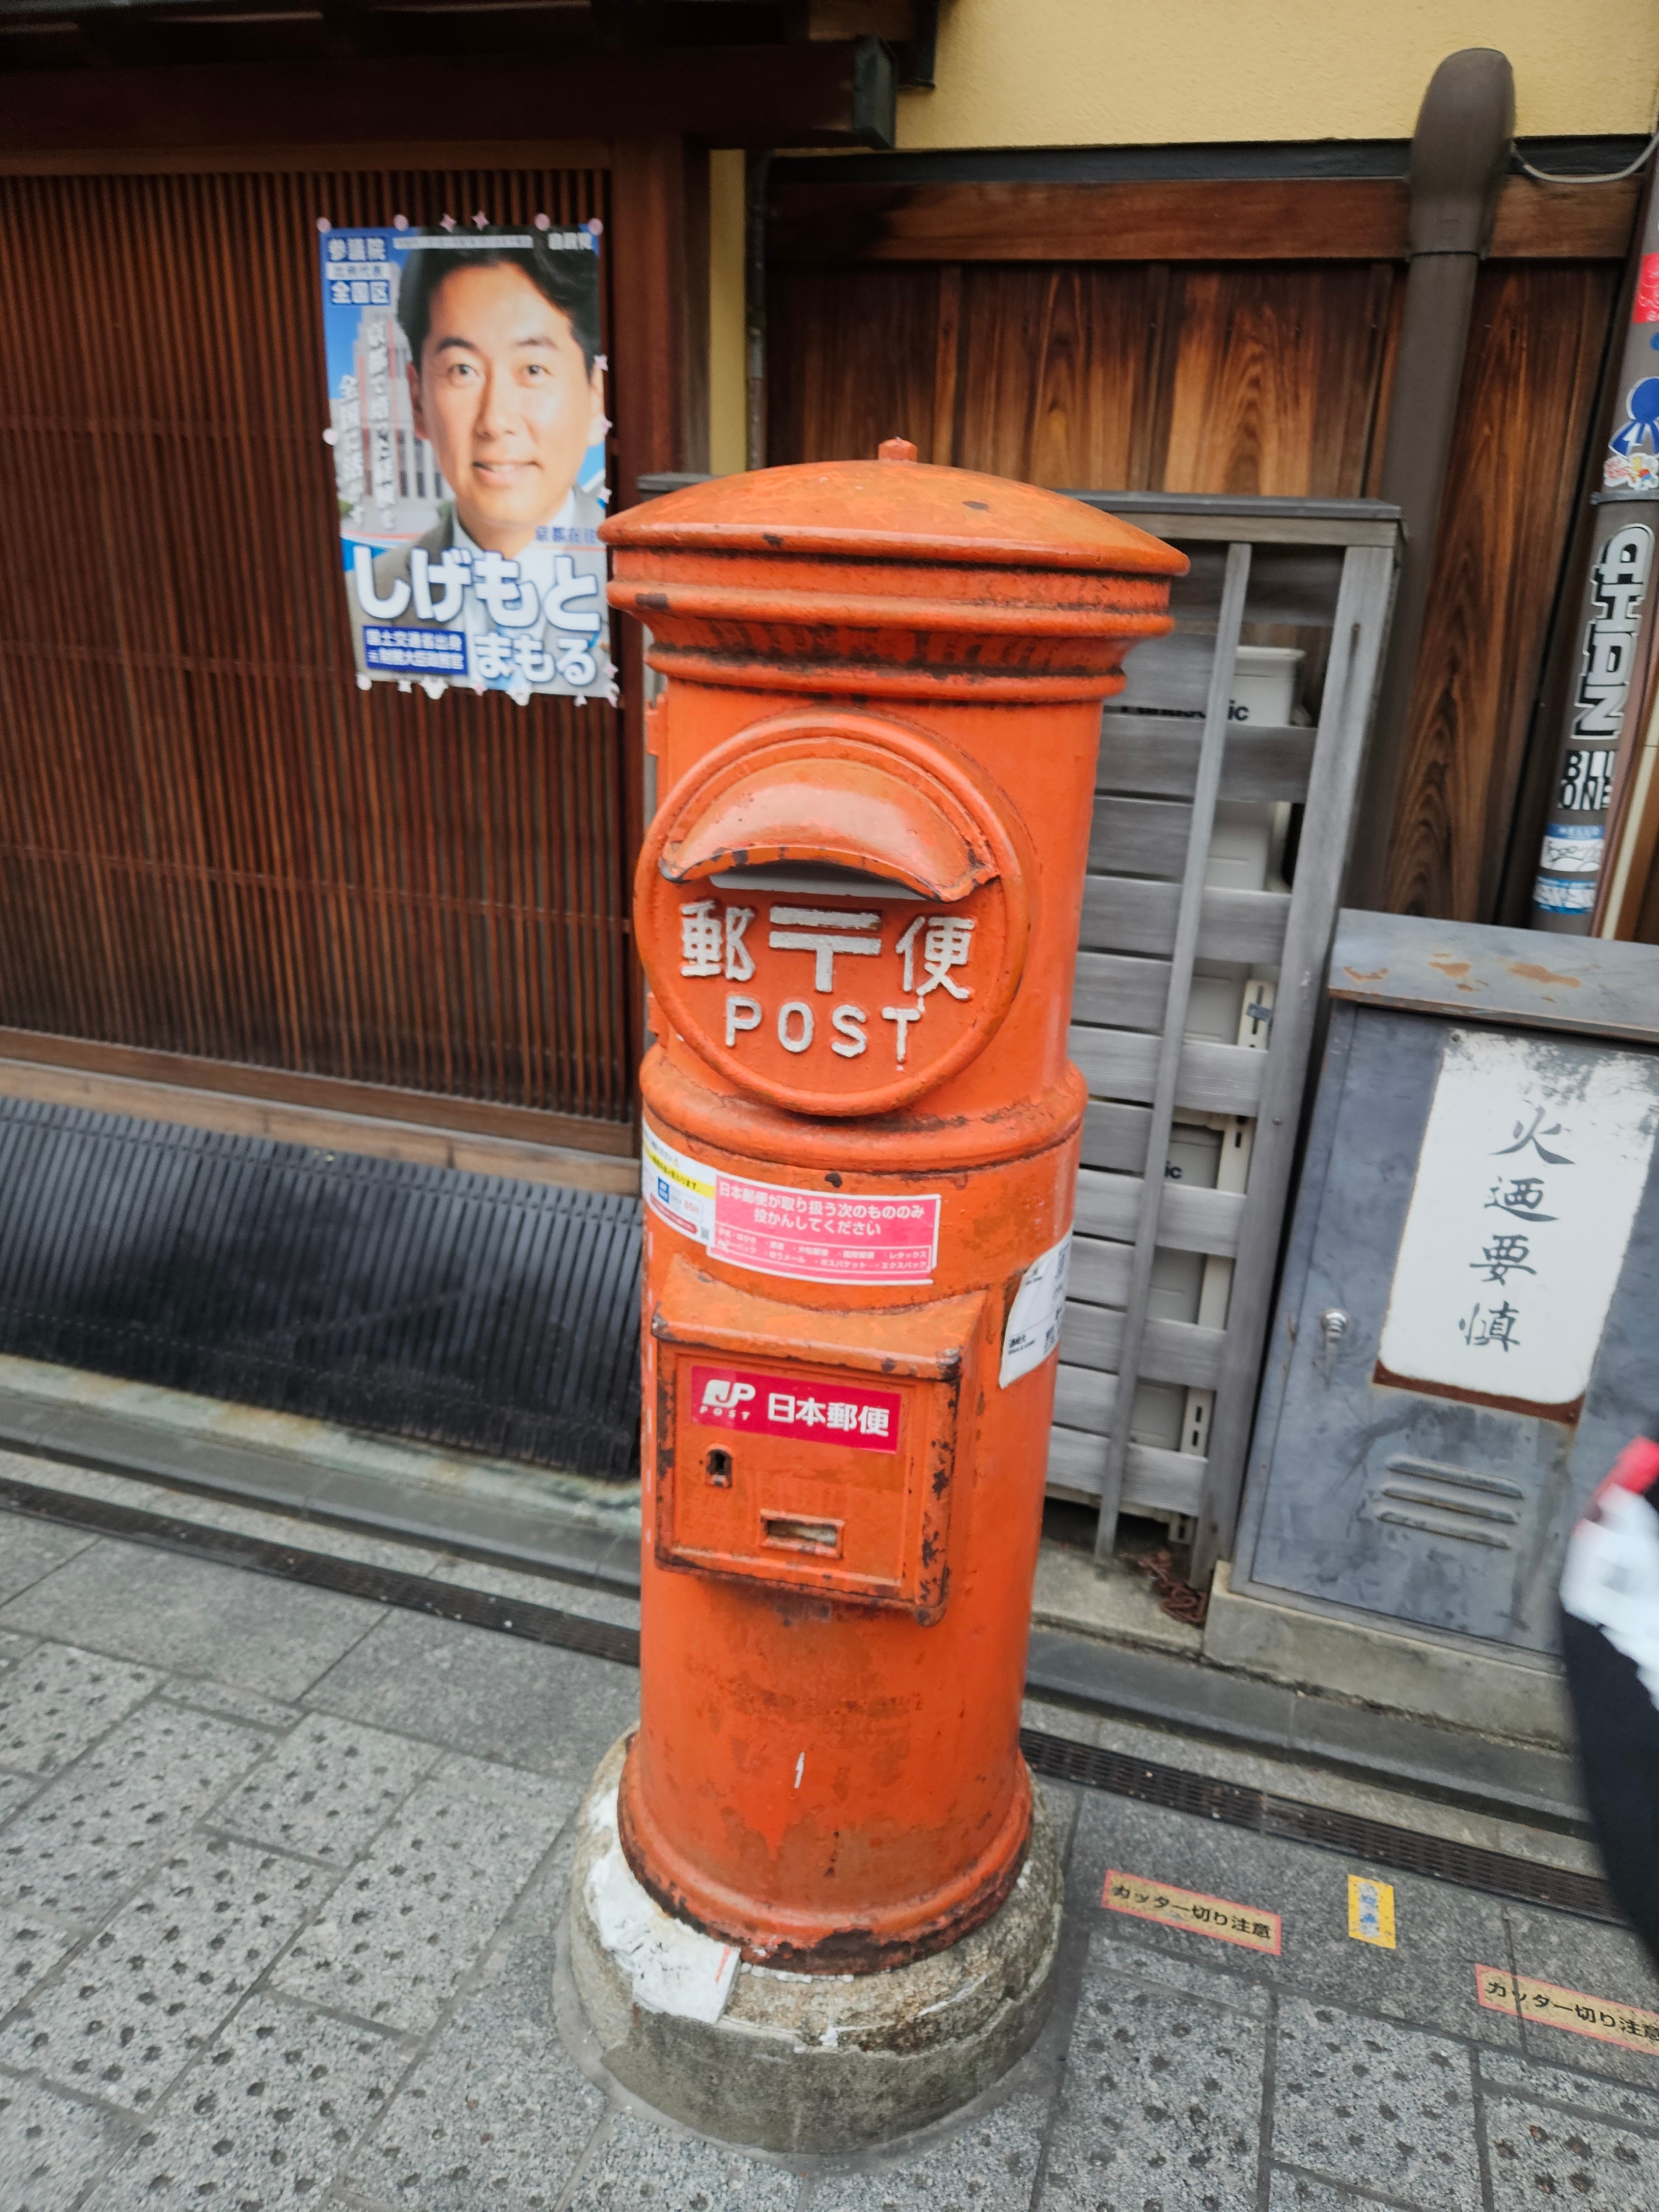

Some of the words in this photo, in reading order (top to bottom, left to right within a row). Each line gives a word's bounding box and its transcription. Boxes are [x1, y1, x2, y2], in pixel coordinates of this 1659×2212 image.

[331, 281, 389, 304] 全国区
[353, 545, 602, 632] しげもと
[474, 632, 598, 687] まもる
[726, 997, 921, 1062] POST
[719, 1181, 925, 1219] 日本郵便が取り扱う次のもののみ
[754, 1208, 881, 1237] 投かんしてください
[699, 1405, 750, 1421] POST
[768, 1392, 890, 1438] 日本郵便
[1113, 1884, 1272, 1940] カッター切り注意
[1484, 1981, 1659, 2042] カッター切り注意
